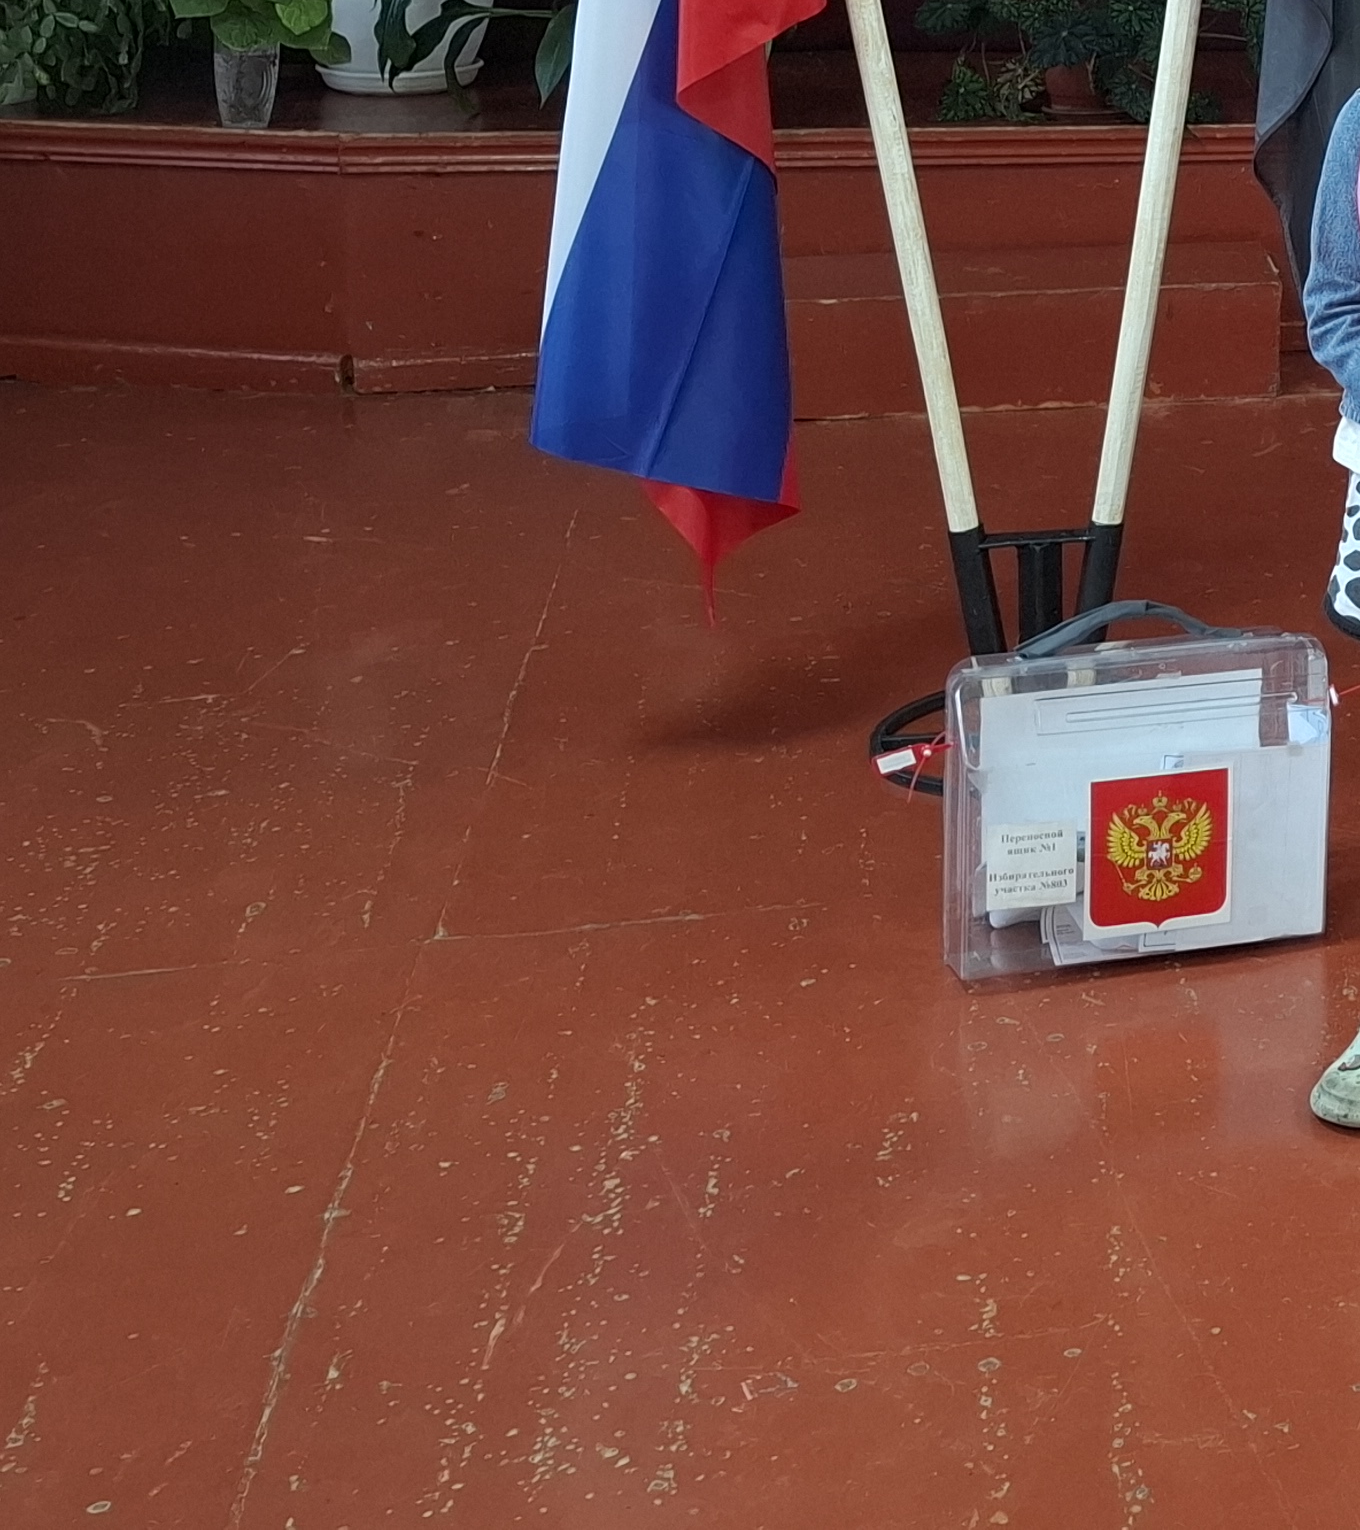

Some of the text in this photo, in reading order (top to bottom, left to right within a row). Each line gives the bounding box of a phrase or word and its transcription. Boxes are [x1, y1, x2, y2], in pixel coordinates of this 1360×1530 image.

[1001, 830, 1063, 844] Переносной
[1007, 842, 1056, 856] ящик №1
[989, 868, 1074, 882] Избирательного
[994, 885, 1036, 896] участка
